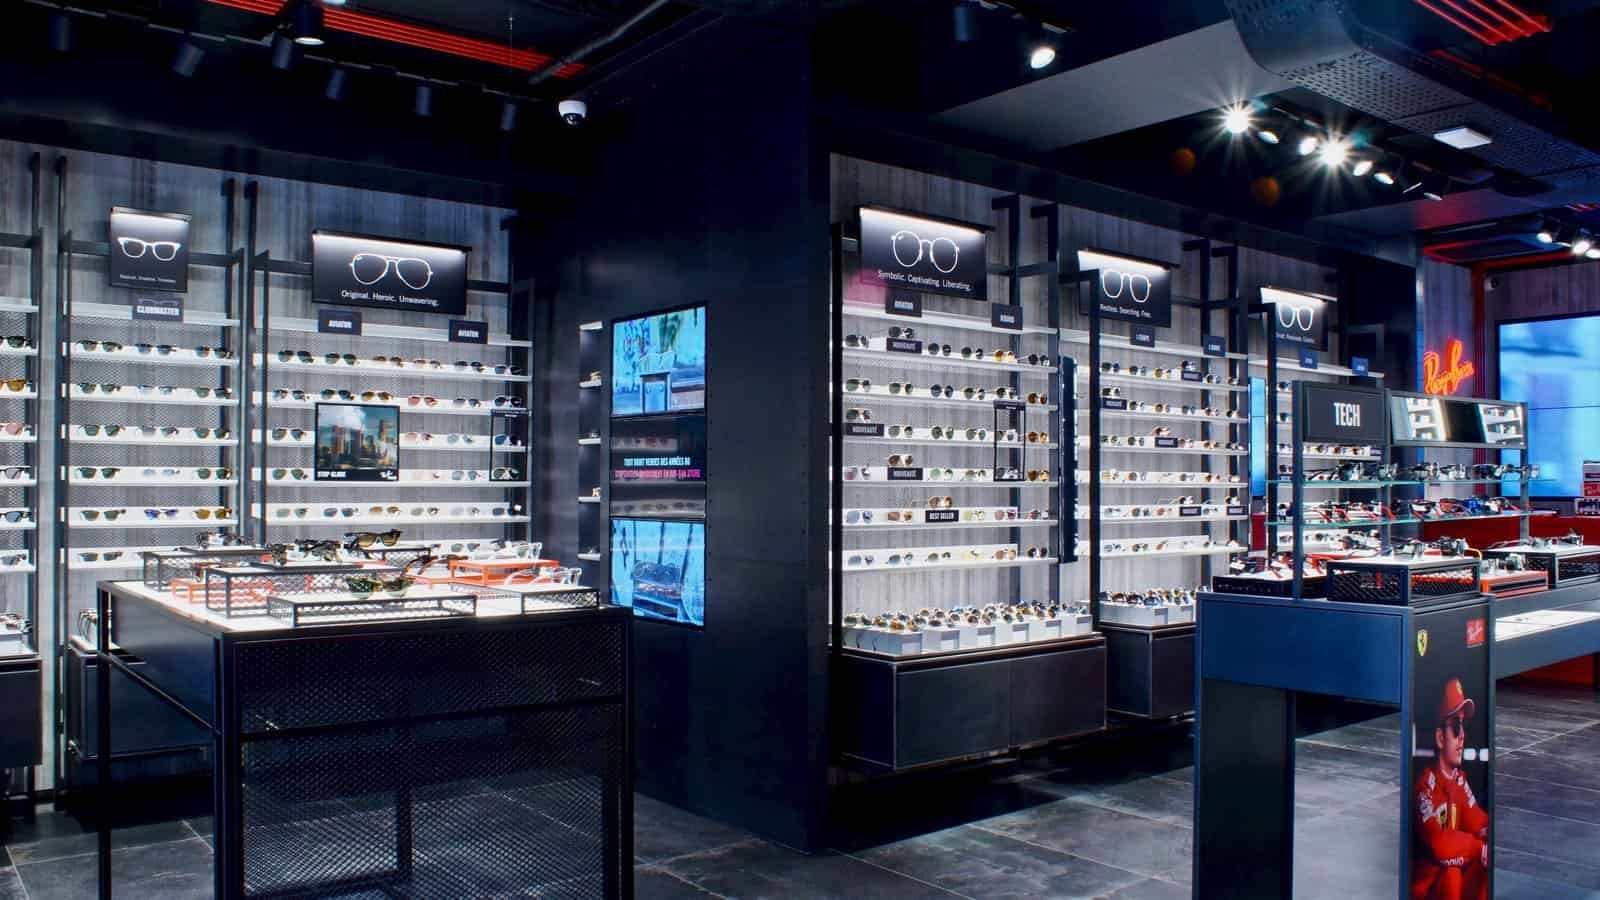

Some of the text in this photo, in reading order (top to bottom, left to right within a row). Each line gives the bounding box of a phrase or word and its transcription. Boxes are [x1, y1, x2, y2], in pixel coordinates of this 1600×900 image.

[877, 269, 972, 292] Symbolic. Captivating. Liberating.
[341, 289, 440, 308] Original. Heroic. Unwavering.
[137, 305, 180, 317] CLUBMASTER
[328, 319, 353, 329] AVIATOR
[458, 329, 480, 338] AVIATOR
[1333, 402, 1361, 427] TECH
[929, 512, 955, 520] BEST SELLER
